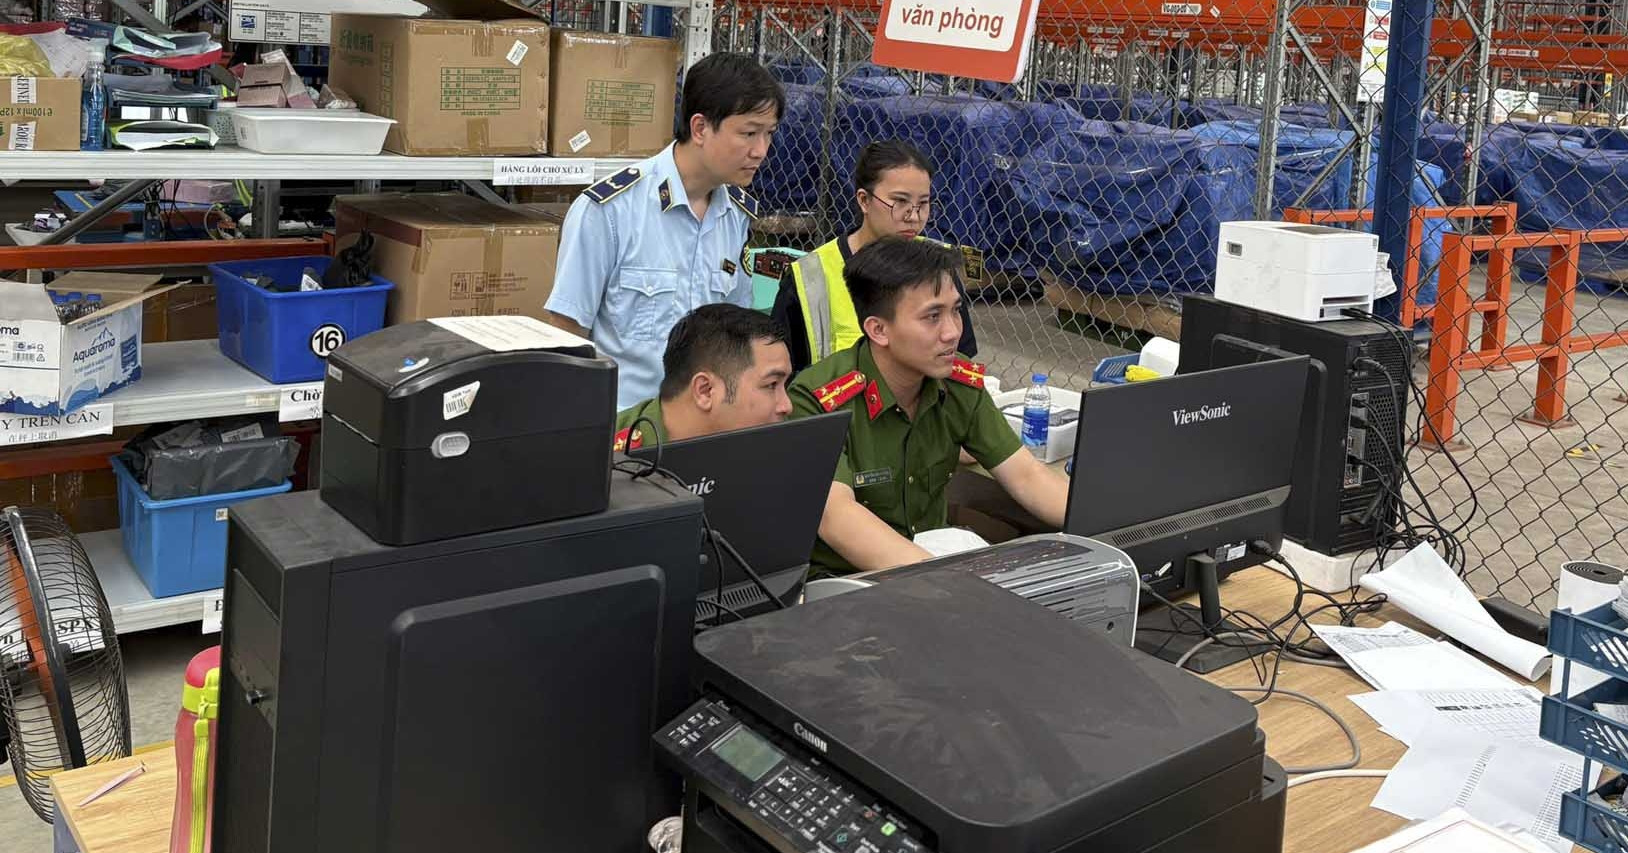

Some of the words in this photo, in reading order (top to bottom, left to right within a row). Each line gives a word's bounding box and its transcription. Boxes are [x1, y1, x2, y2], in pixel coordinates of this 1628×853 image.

[902, 4, 934, 26] văn
[938, 6, 1004, 39] phòng
[73, 338, 116, 363] Aquaroma
[315, 330, 339, 353] 16
[290, 388, 322, 402] Chờ
[1172, 401, 1231, 426] ViewSonic
[794, 722, 828, 752] Canon
